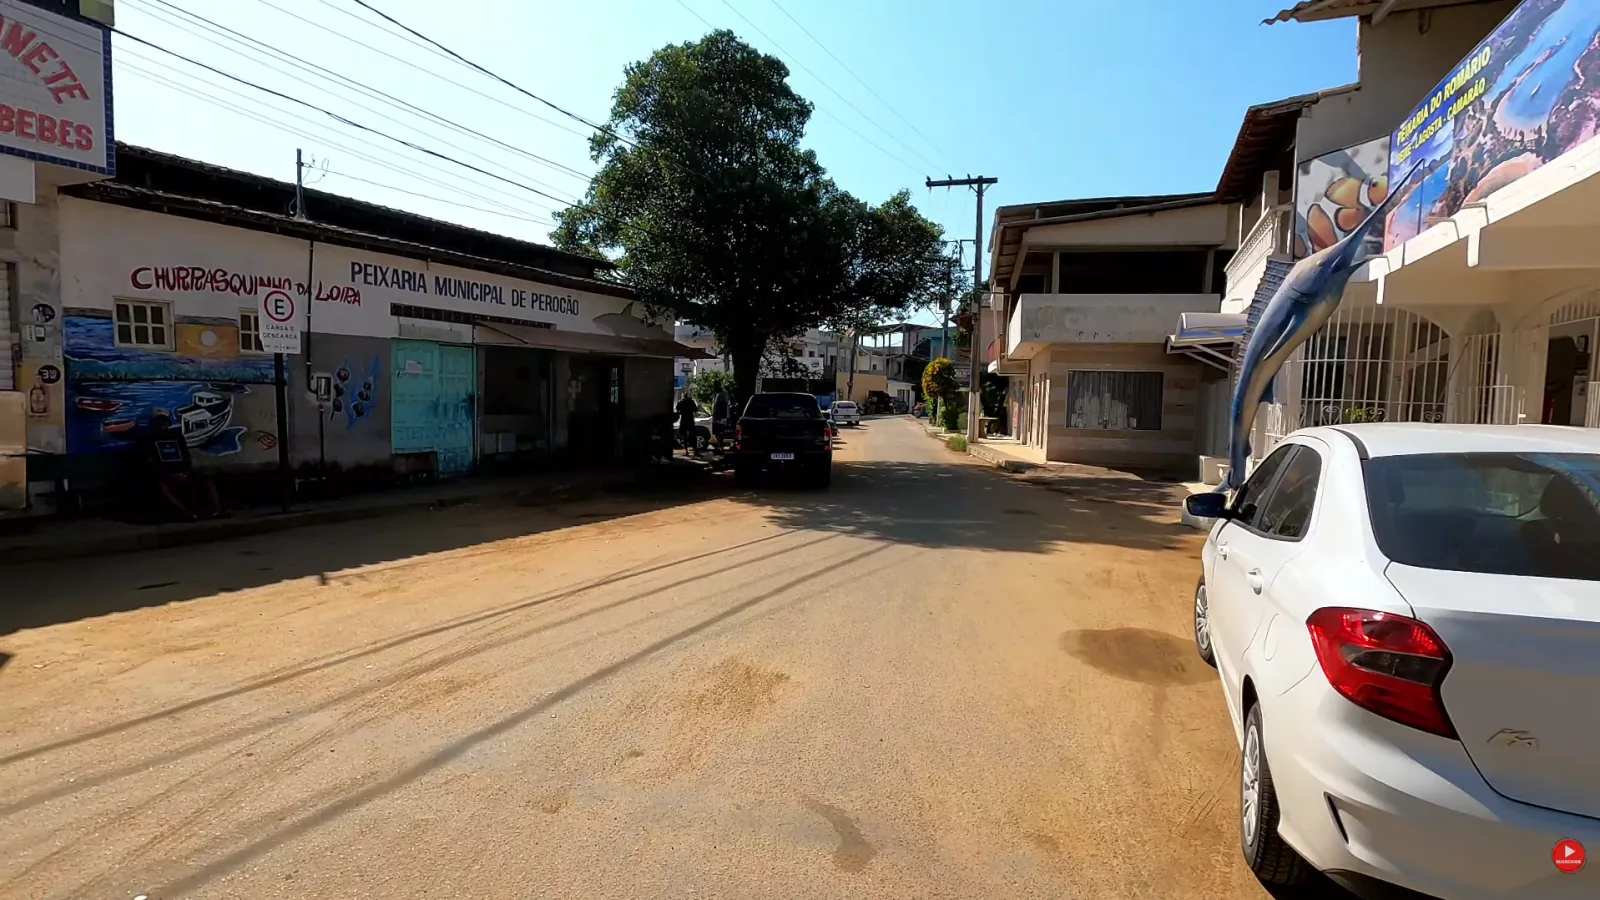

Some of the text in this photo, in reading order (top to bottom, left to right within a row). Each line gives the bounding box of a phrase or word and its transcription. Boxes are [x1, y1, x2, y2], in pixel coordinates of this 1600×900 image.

[0, 13, 91, 105] NETE
[1397, 46, 1491, 146] PEIXARIA DO ROMÁRIO
[0, 104, 93, 151] BEBES
[1415, 116, 1442, 149] LAGOSTA
[315, 280, 361, 307] LOIRA
[351, 261, 579, 316] PEIXARIA MUNICIPAL DE PEROCÃO
[274, 298, 285, 315] E
[263, 332, 298, 340] DESCARGA
[266, 324, 288, 332] CARGA
